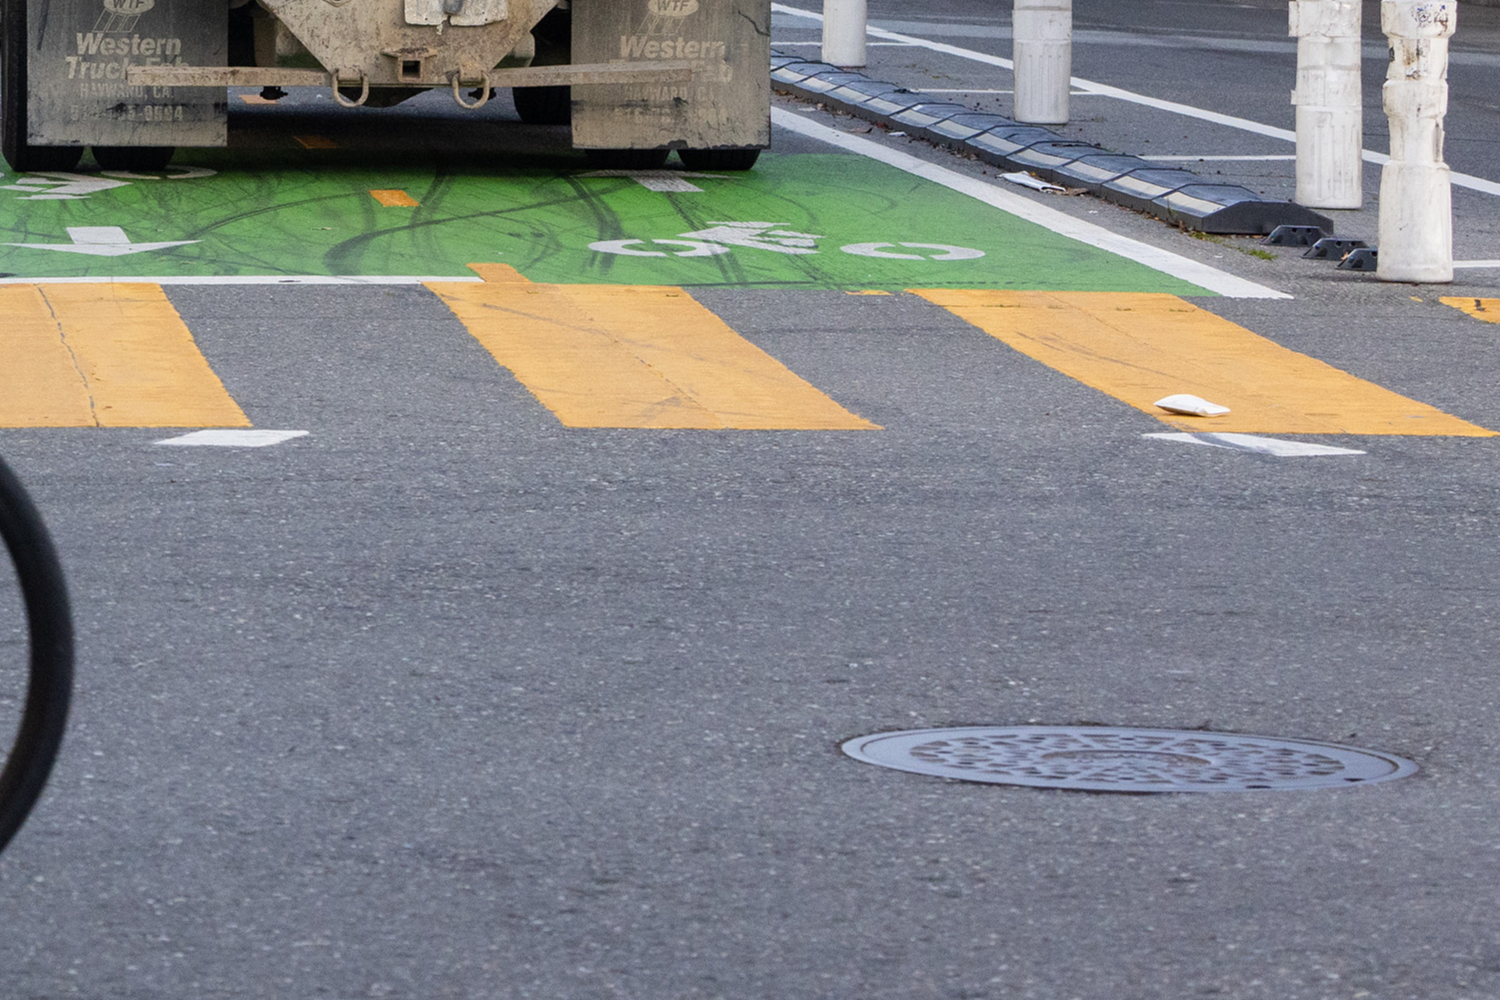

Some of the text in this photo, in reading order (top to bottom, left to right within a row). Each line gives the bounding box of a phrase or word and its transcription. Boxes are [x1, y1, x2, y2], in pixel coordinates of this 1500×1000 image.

[655, 0, 690, 11] WTF
[76, 32, 182, 56] Western
[620, 35, 726, 59] Western
